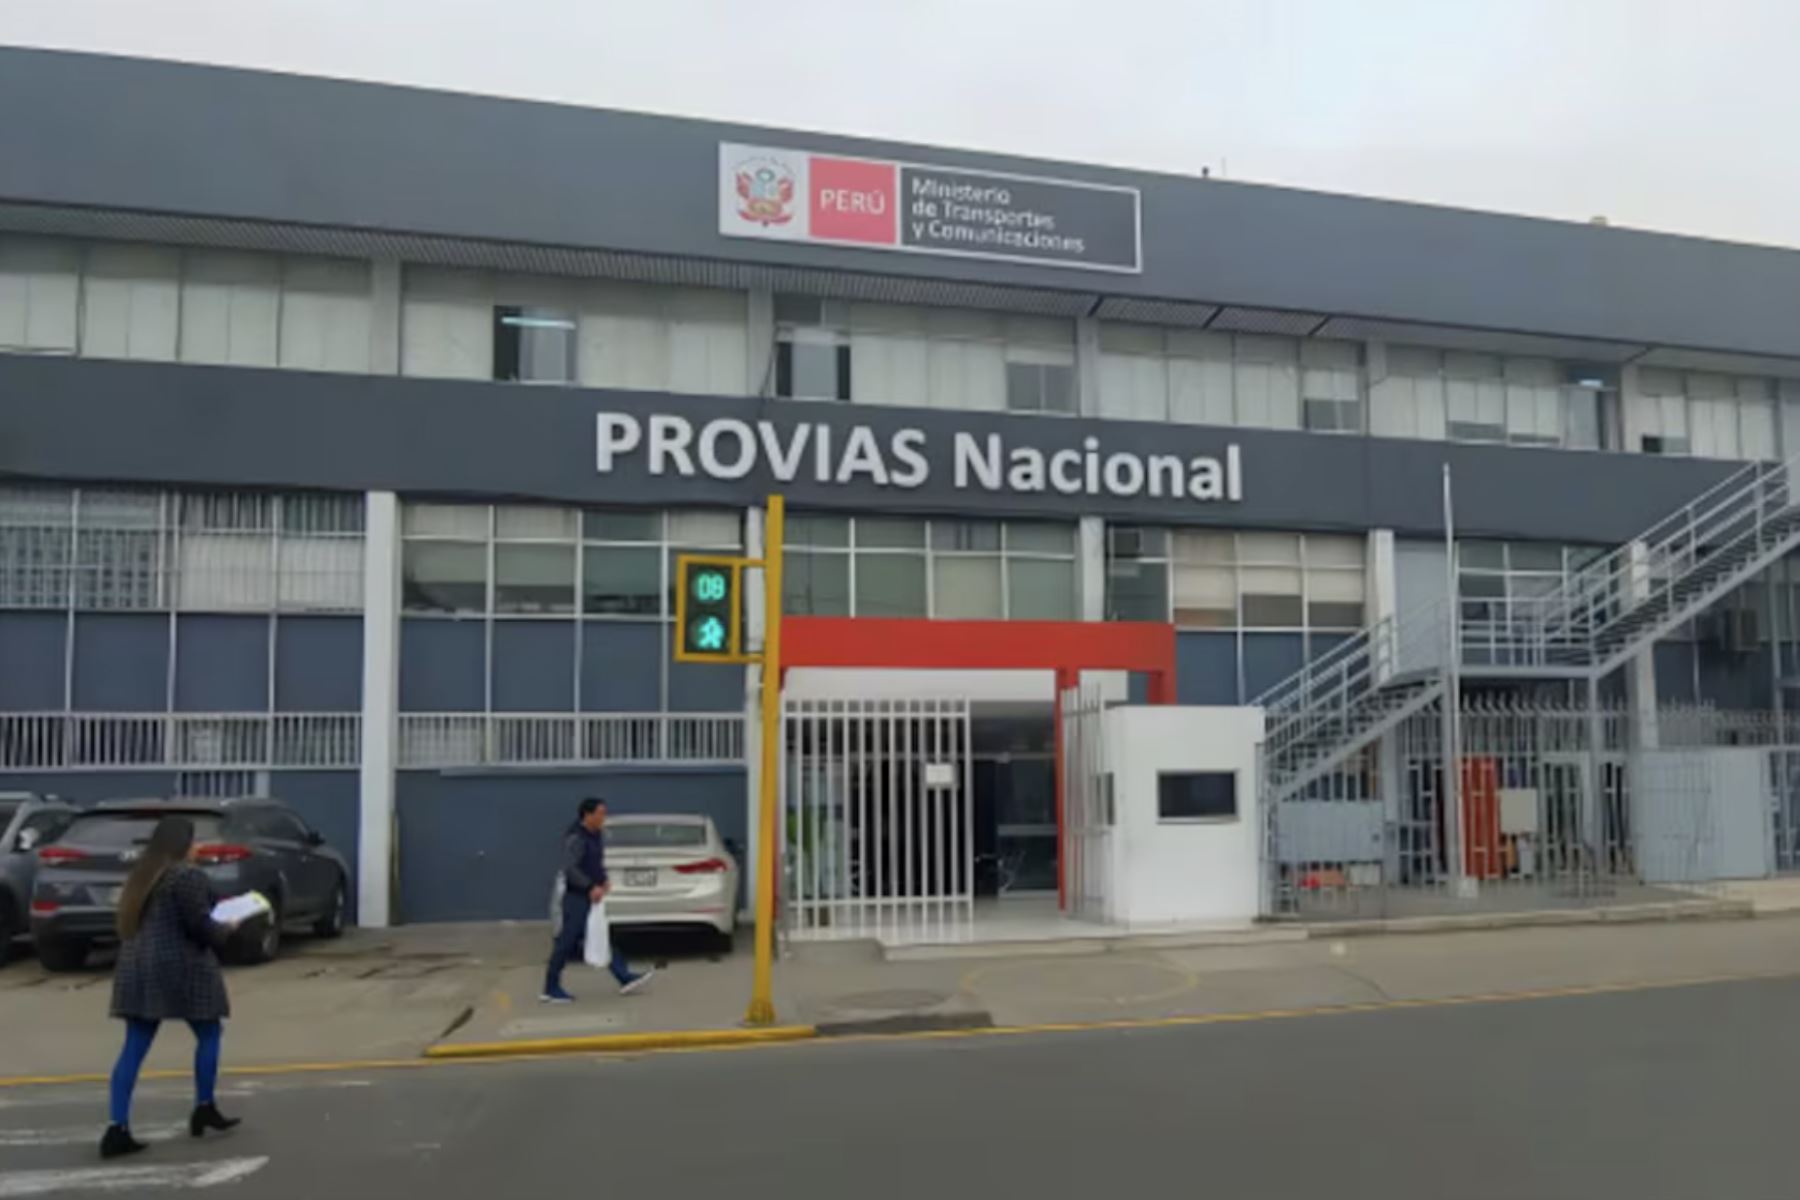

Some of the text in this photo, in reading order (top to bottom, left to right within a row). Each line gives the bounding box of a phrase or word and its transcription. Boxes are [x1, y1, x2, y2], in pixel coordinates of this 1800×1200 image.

[821, 188, 886, 215] PERÚ
[912, 178, 1010, 204] Ministerio
[912, 200, 1055, 230] de Transportes
[913, 220, 1085, 253] y Comunicaciones
[596, 411, 1242, 501] PROVIAS Nacional
